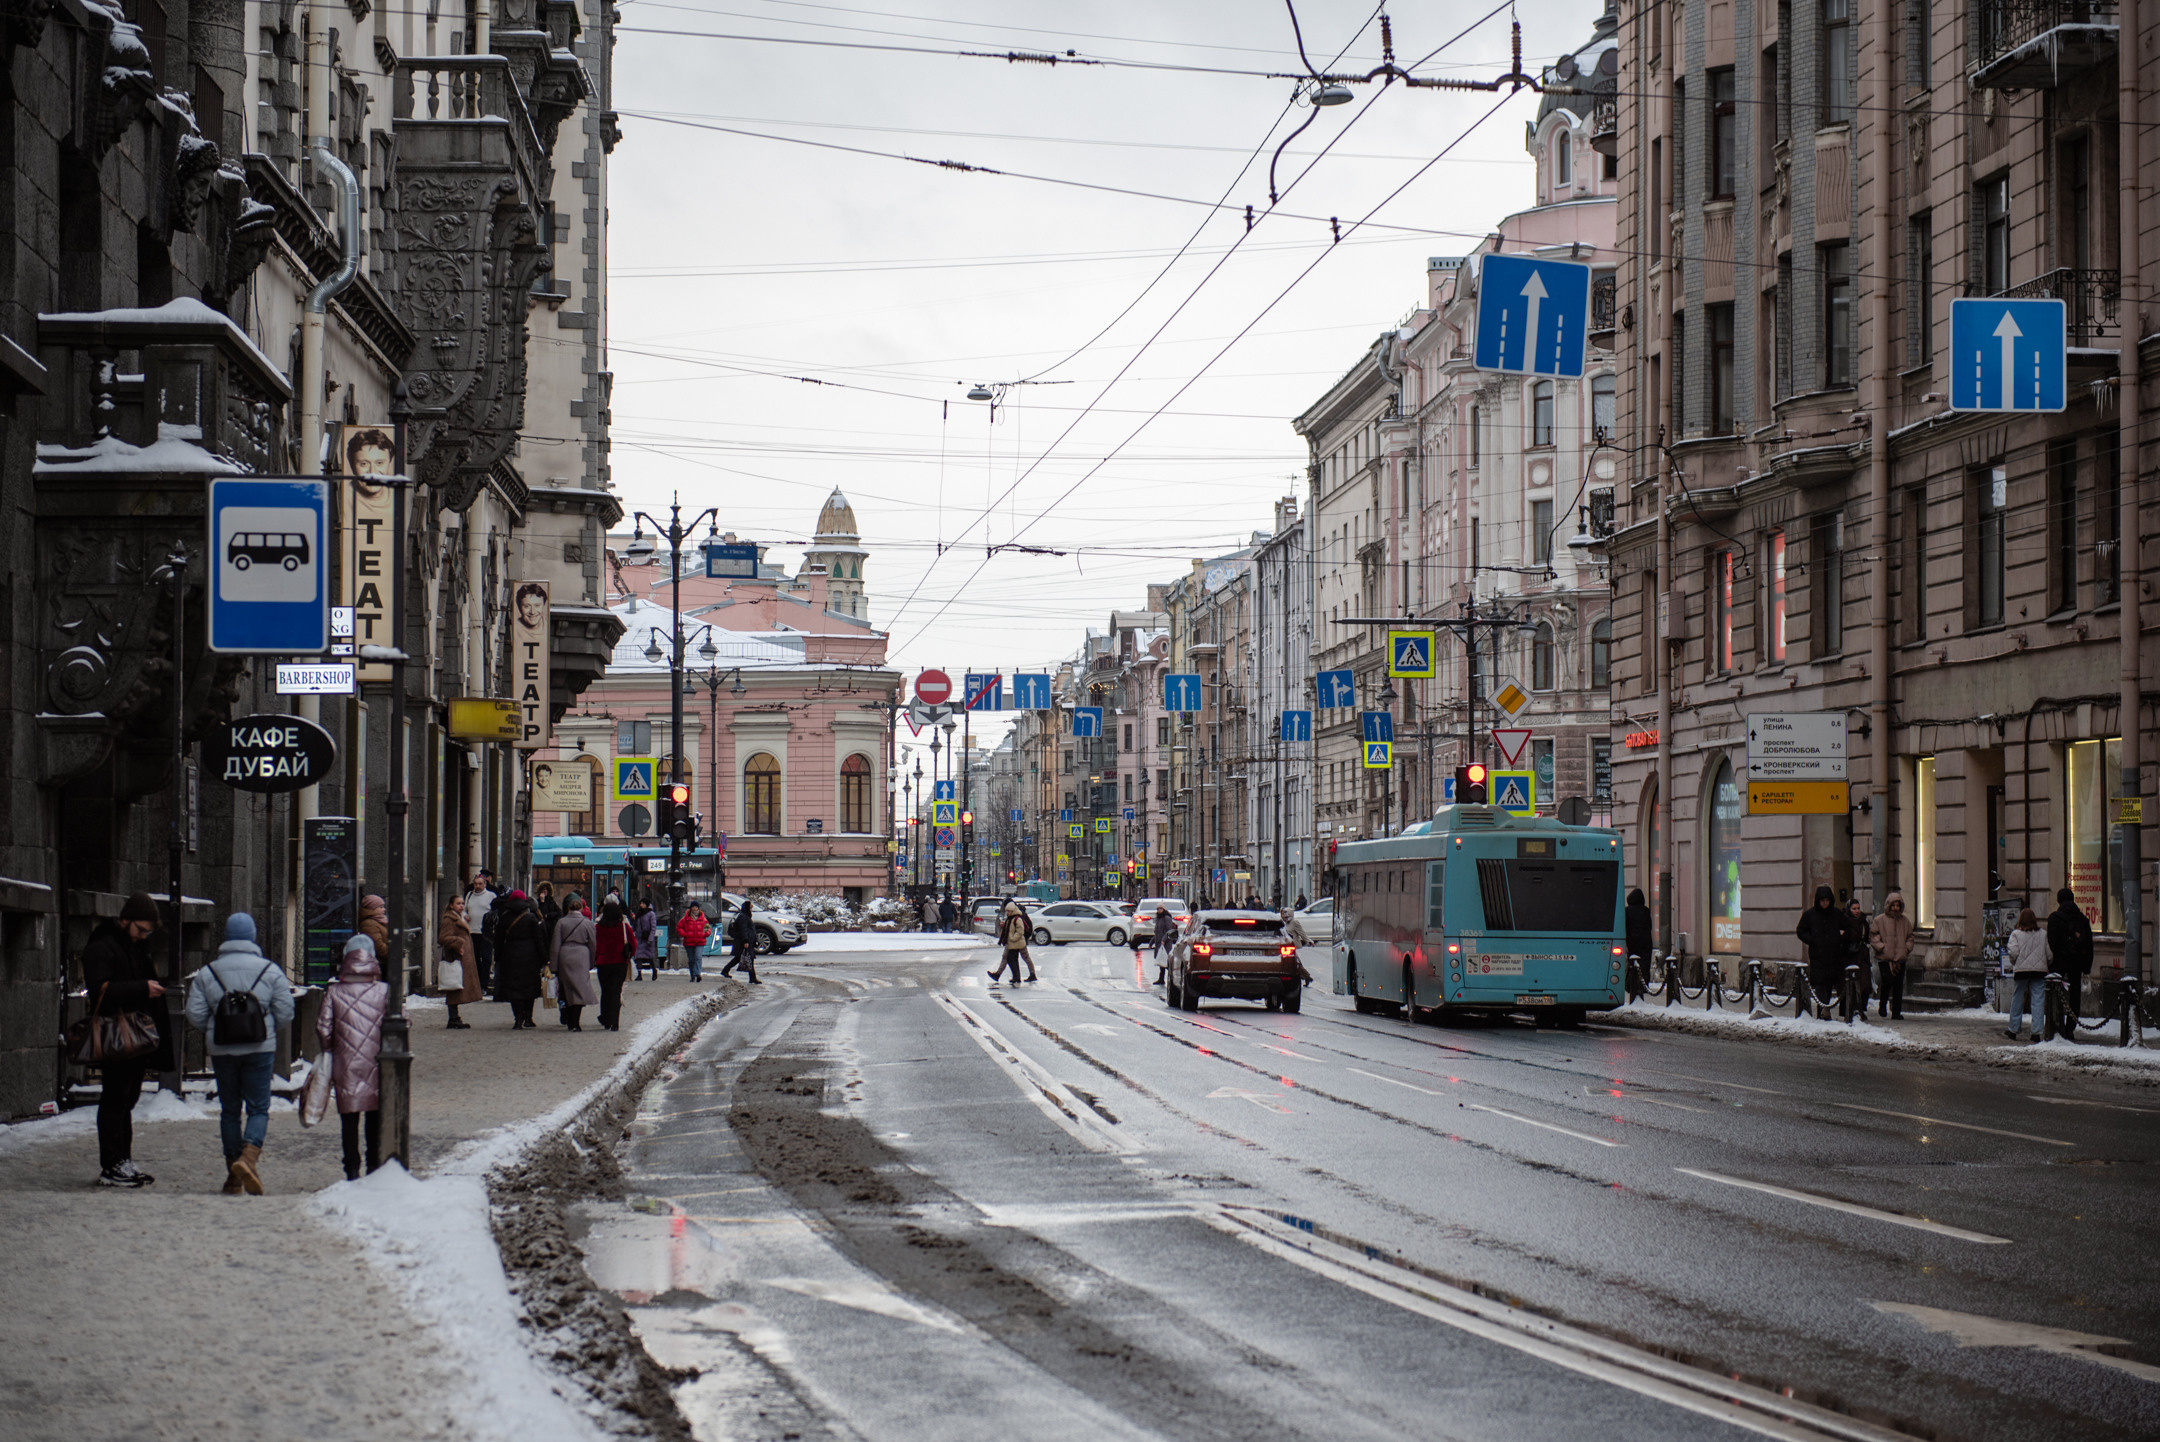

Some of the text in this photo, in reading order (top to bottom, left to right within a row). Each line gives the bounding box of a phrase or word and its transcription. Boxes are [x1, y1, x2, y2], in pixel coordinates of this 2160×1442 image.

[279, 671, 351, 685] BARBERSHOP
[522, 642, 540, 741] ТЕАТР
[231, 726, 299, 748] КАФЕ
[223, 751, 309, 781] ДУБАЙ
[1460, 929, 1484, 937] 38365
[1716, 922, 1734, 940] DNS
